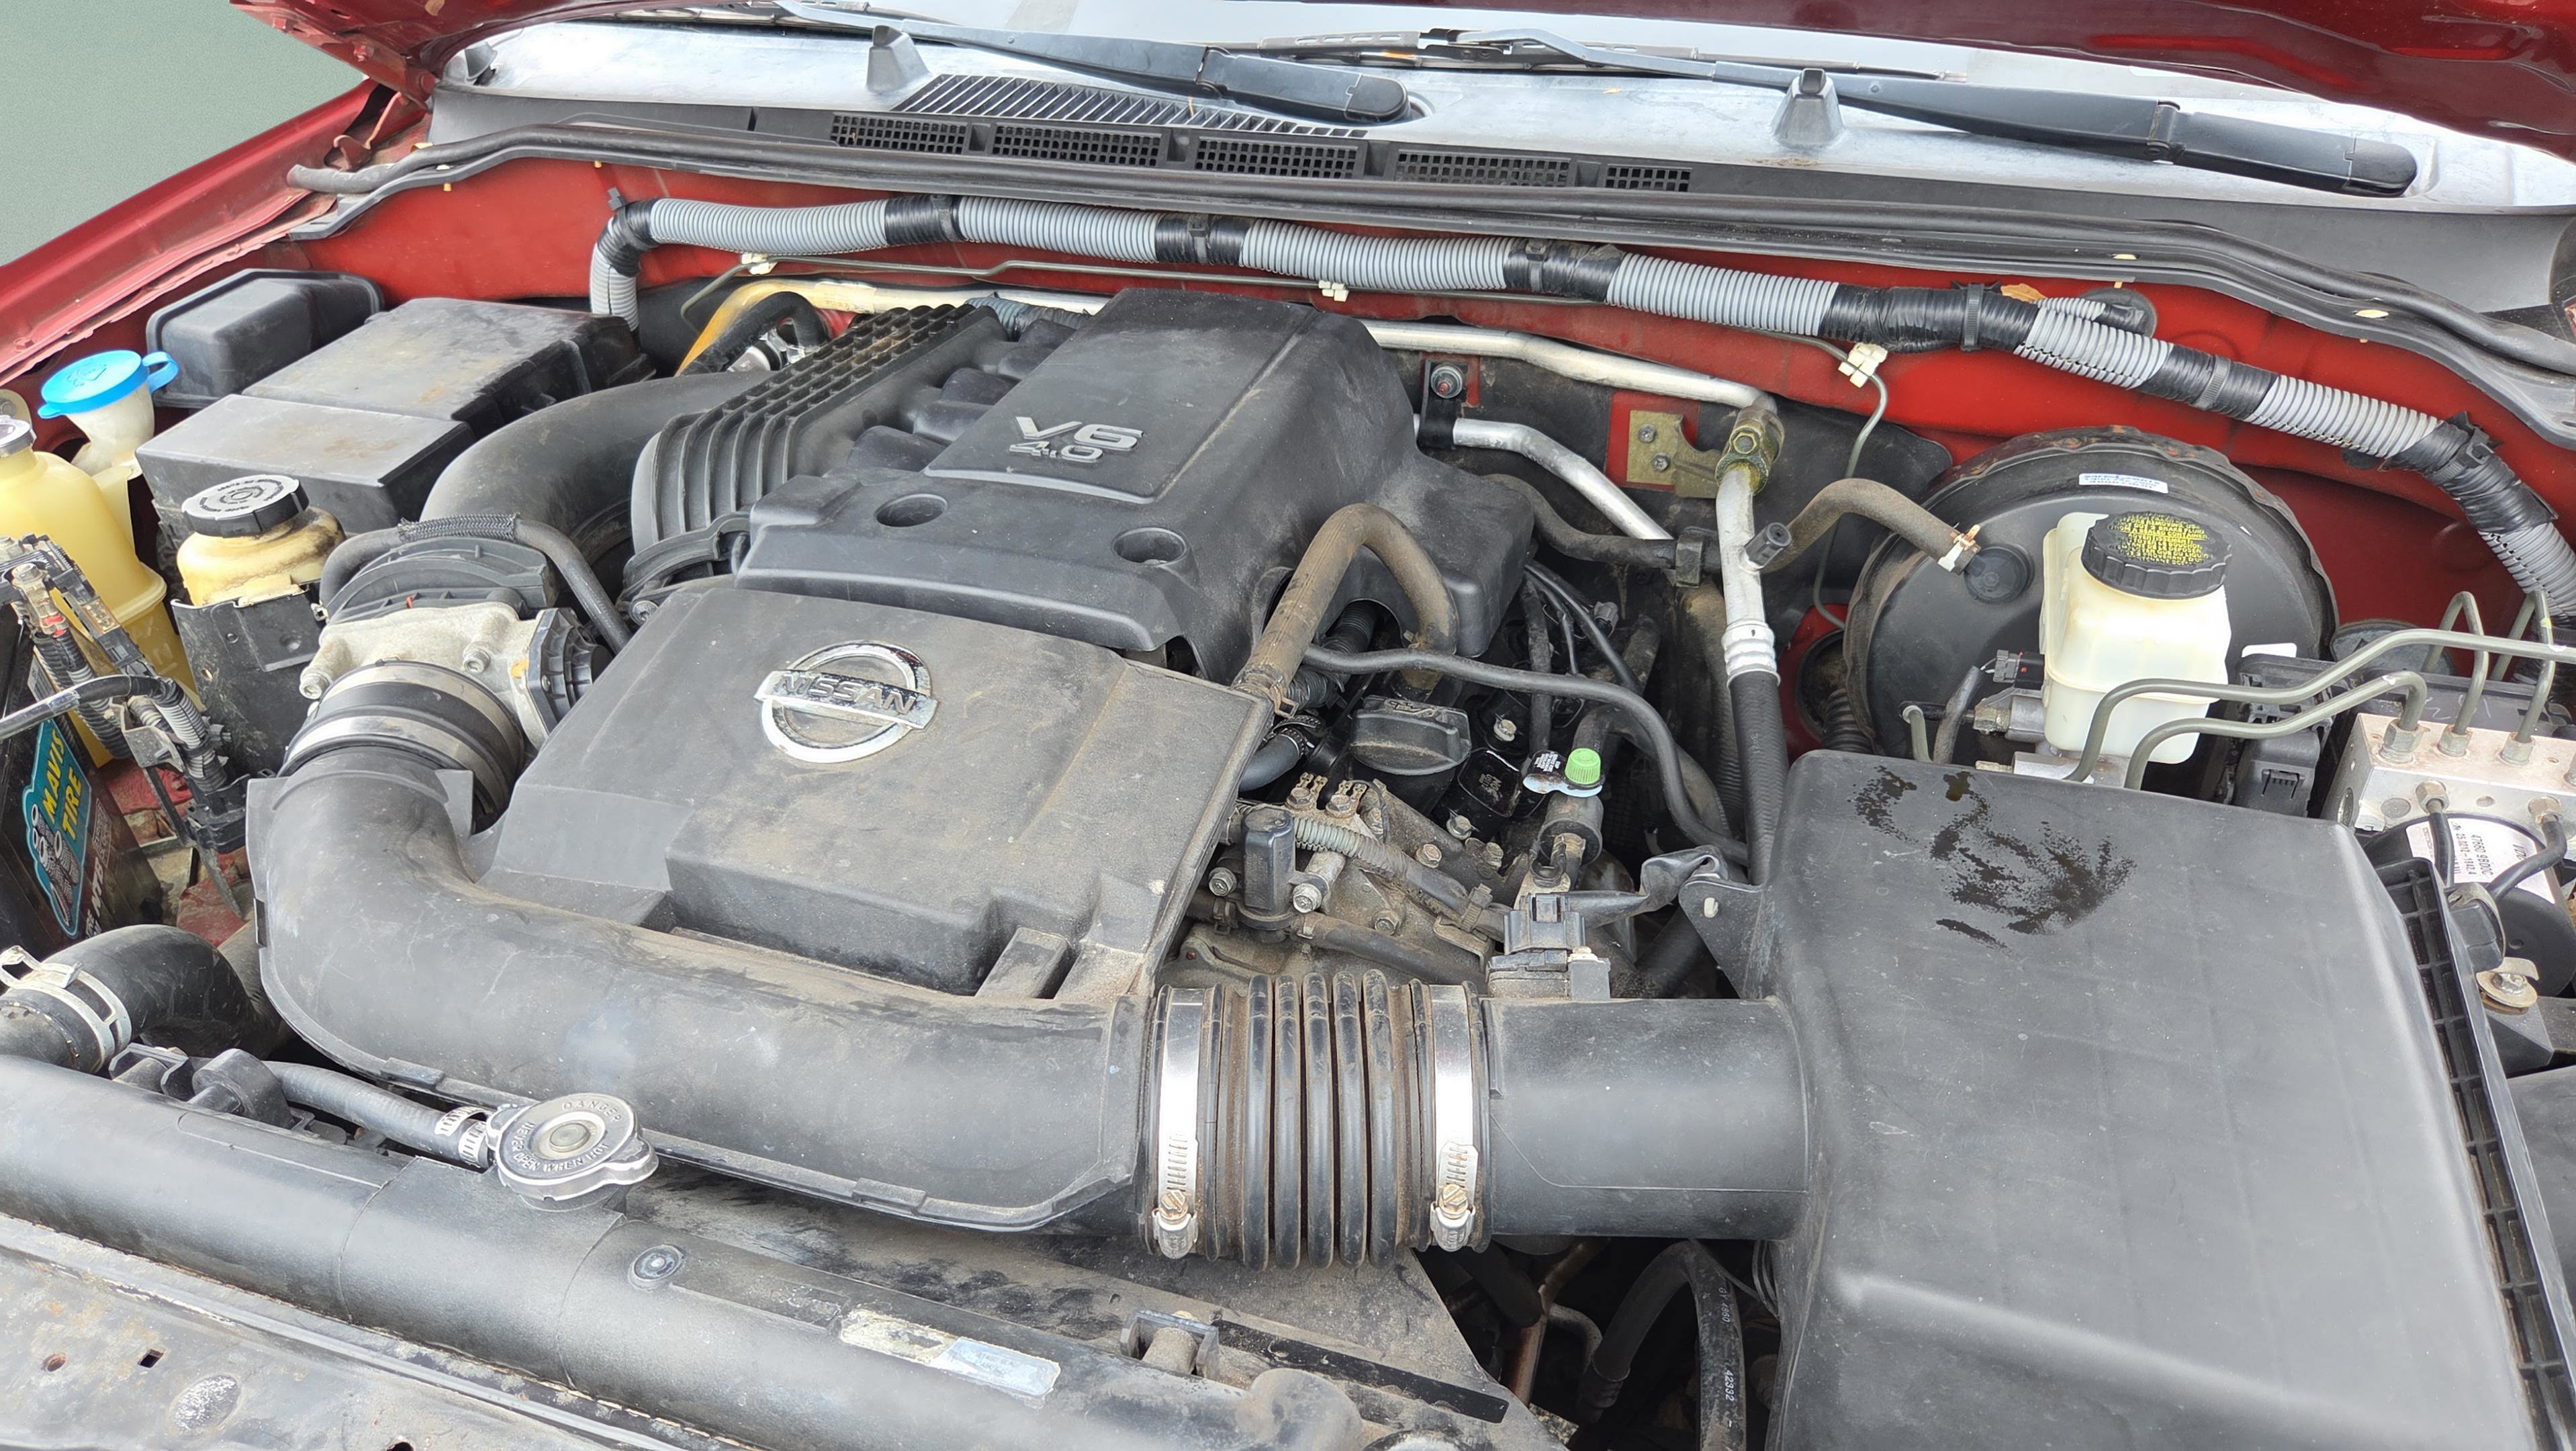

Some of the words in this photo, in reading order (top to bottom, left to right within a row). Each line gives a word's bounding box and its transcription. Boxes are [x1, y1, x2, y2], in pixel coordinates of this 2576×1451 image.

[1016, 416, 1143, 451] V6
[1009, 441, 1105, 463] 4.0
[775, 672, 917, 715] NISSAN
[42, 729, 65, 824] MAVIS
[62, 766, 82, 841] TIRE
[563, 1101, 622, 1122] DANGER
[514, 1151, 541, 1172] OPEN
[543, 1158, 584, 1173] WHEN
[587, 1143, 610, 1162] HOT
